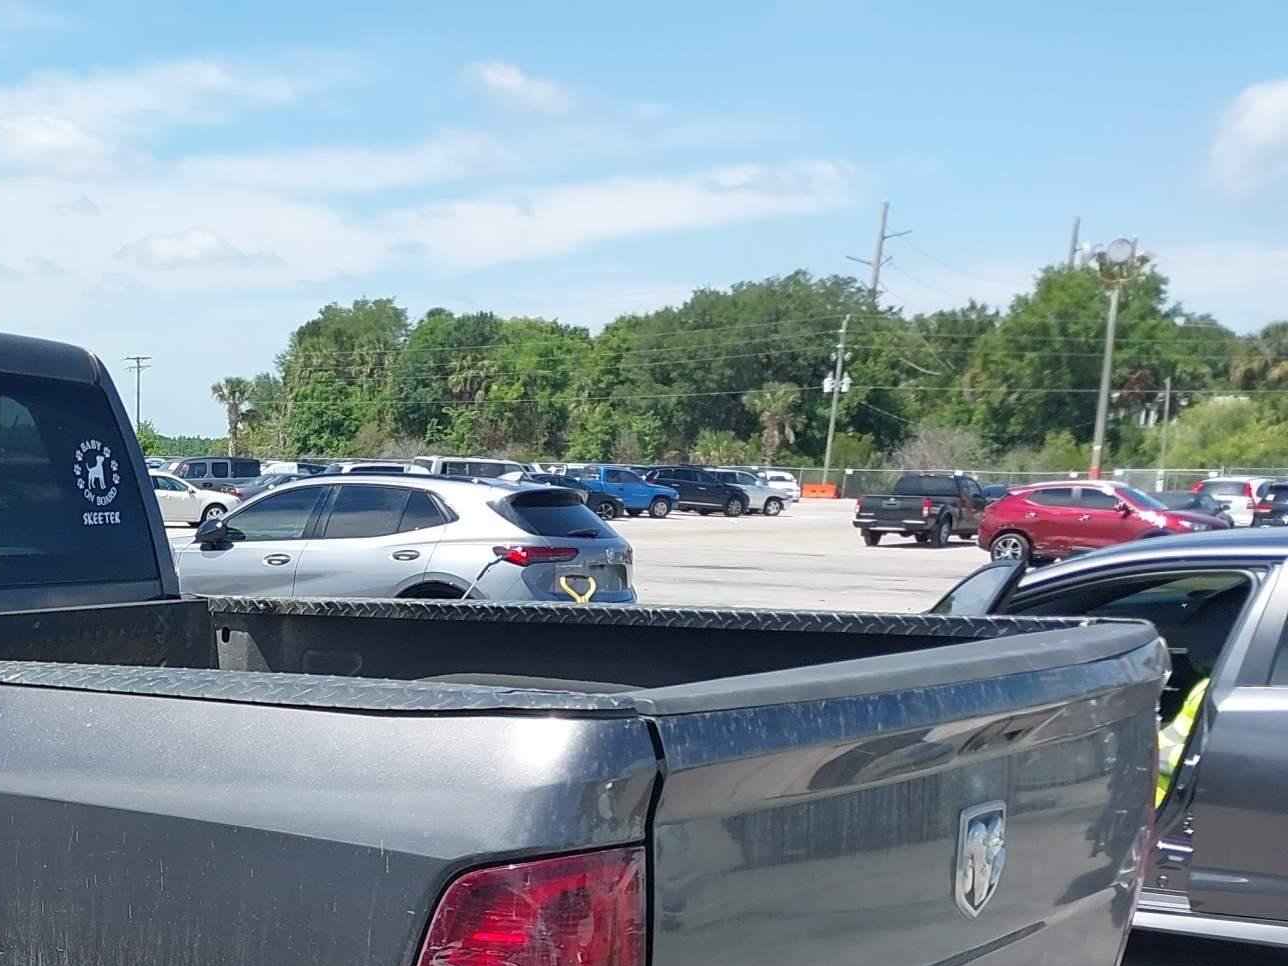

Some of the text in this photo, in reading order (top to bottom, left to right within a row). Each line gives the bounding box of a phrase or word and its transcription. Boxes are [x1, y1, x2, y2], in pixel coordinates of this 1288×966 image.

[80, 439, 102, 453] BABY
[83, 486, 118, 506] ON BOARD
[82, 511, 121, 526] SKEETER
